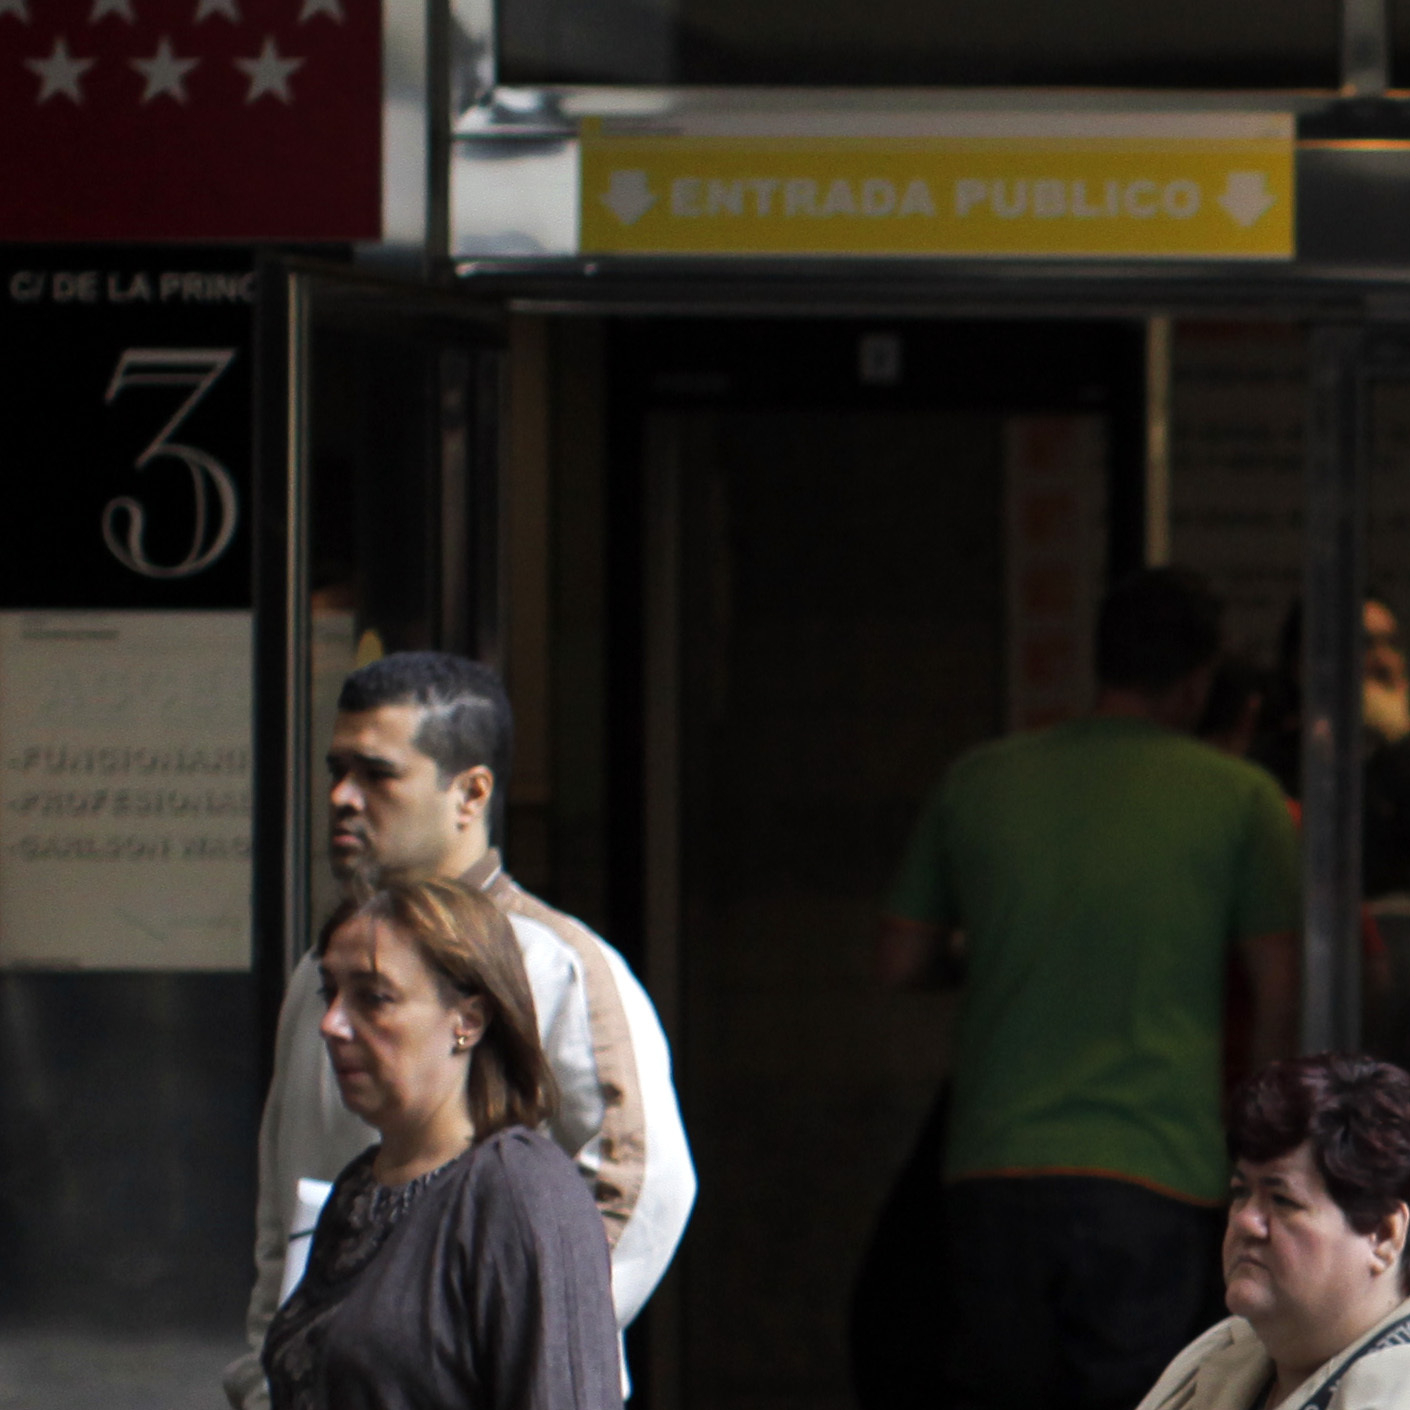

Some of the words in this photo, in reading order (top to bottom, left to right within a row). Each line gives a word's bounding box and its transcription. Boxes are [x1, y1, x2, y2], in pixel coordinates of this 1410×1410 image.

[670, 179, 935, 216] ENTRADA
[955, 179, 1200, 217] PUBLICO
[9, 269, 48, 303] C/
[52, 269, 100, 303] DE
[106, 269, 151, 303] LA
[104, 348, 239, 578] 3
